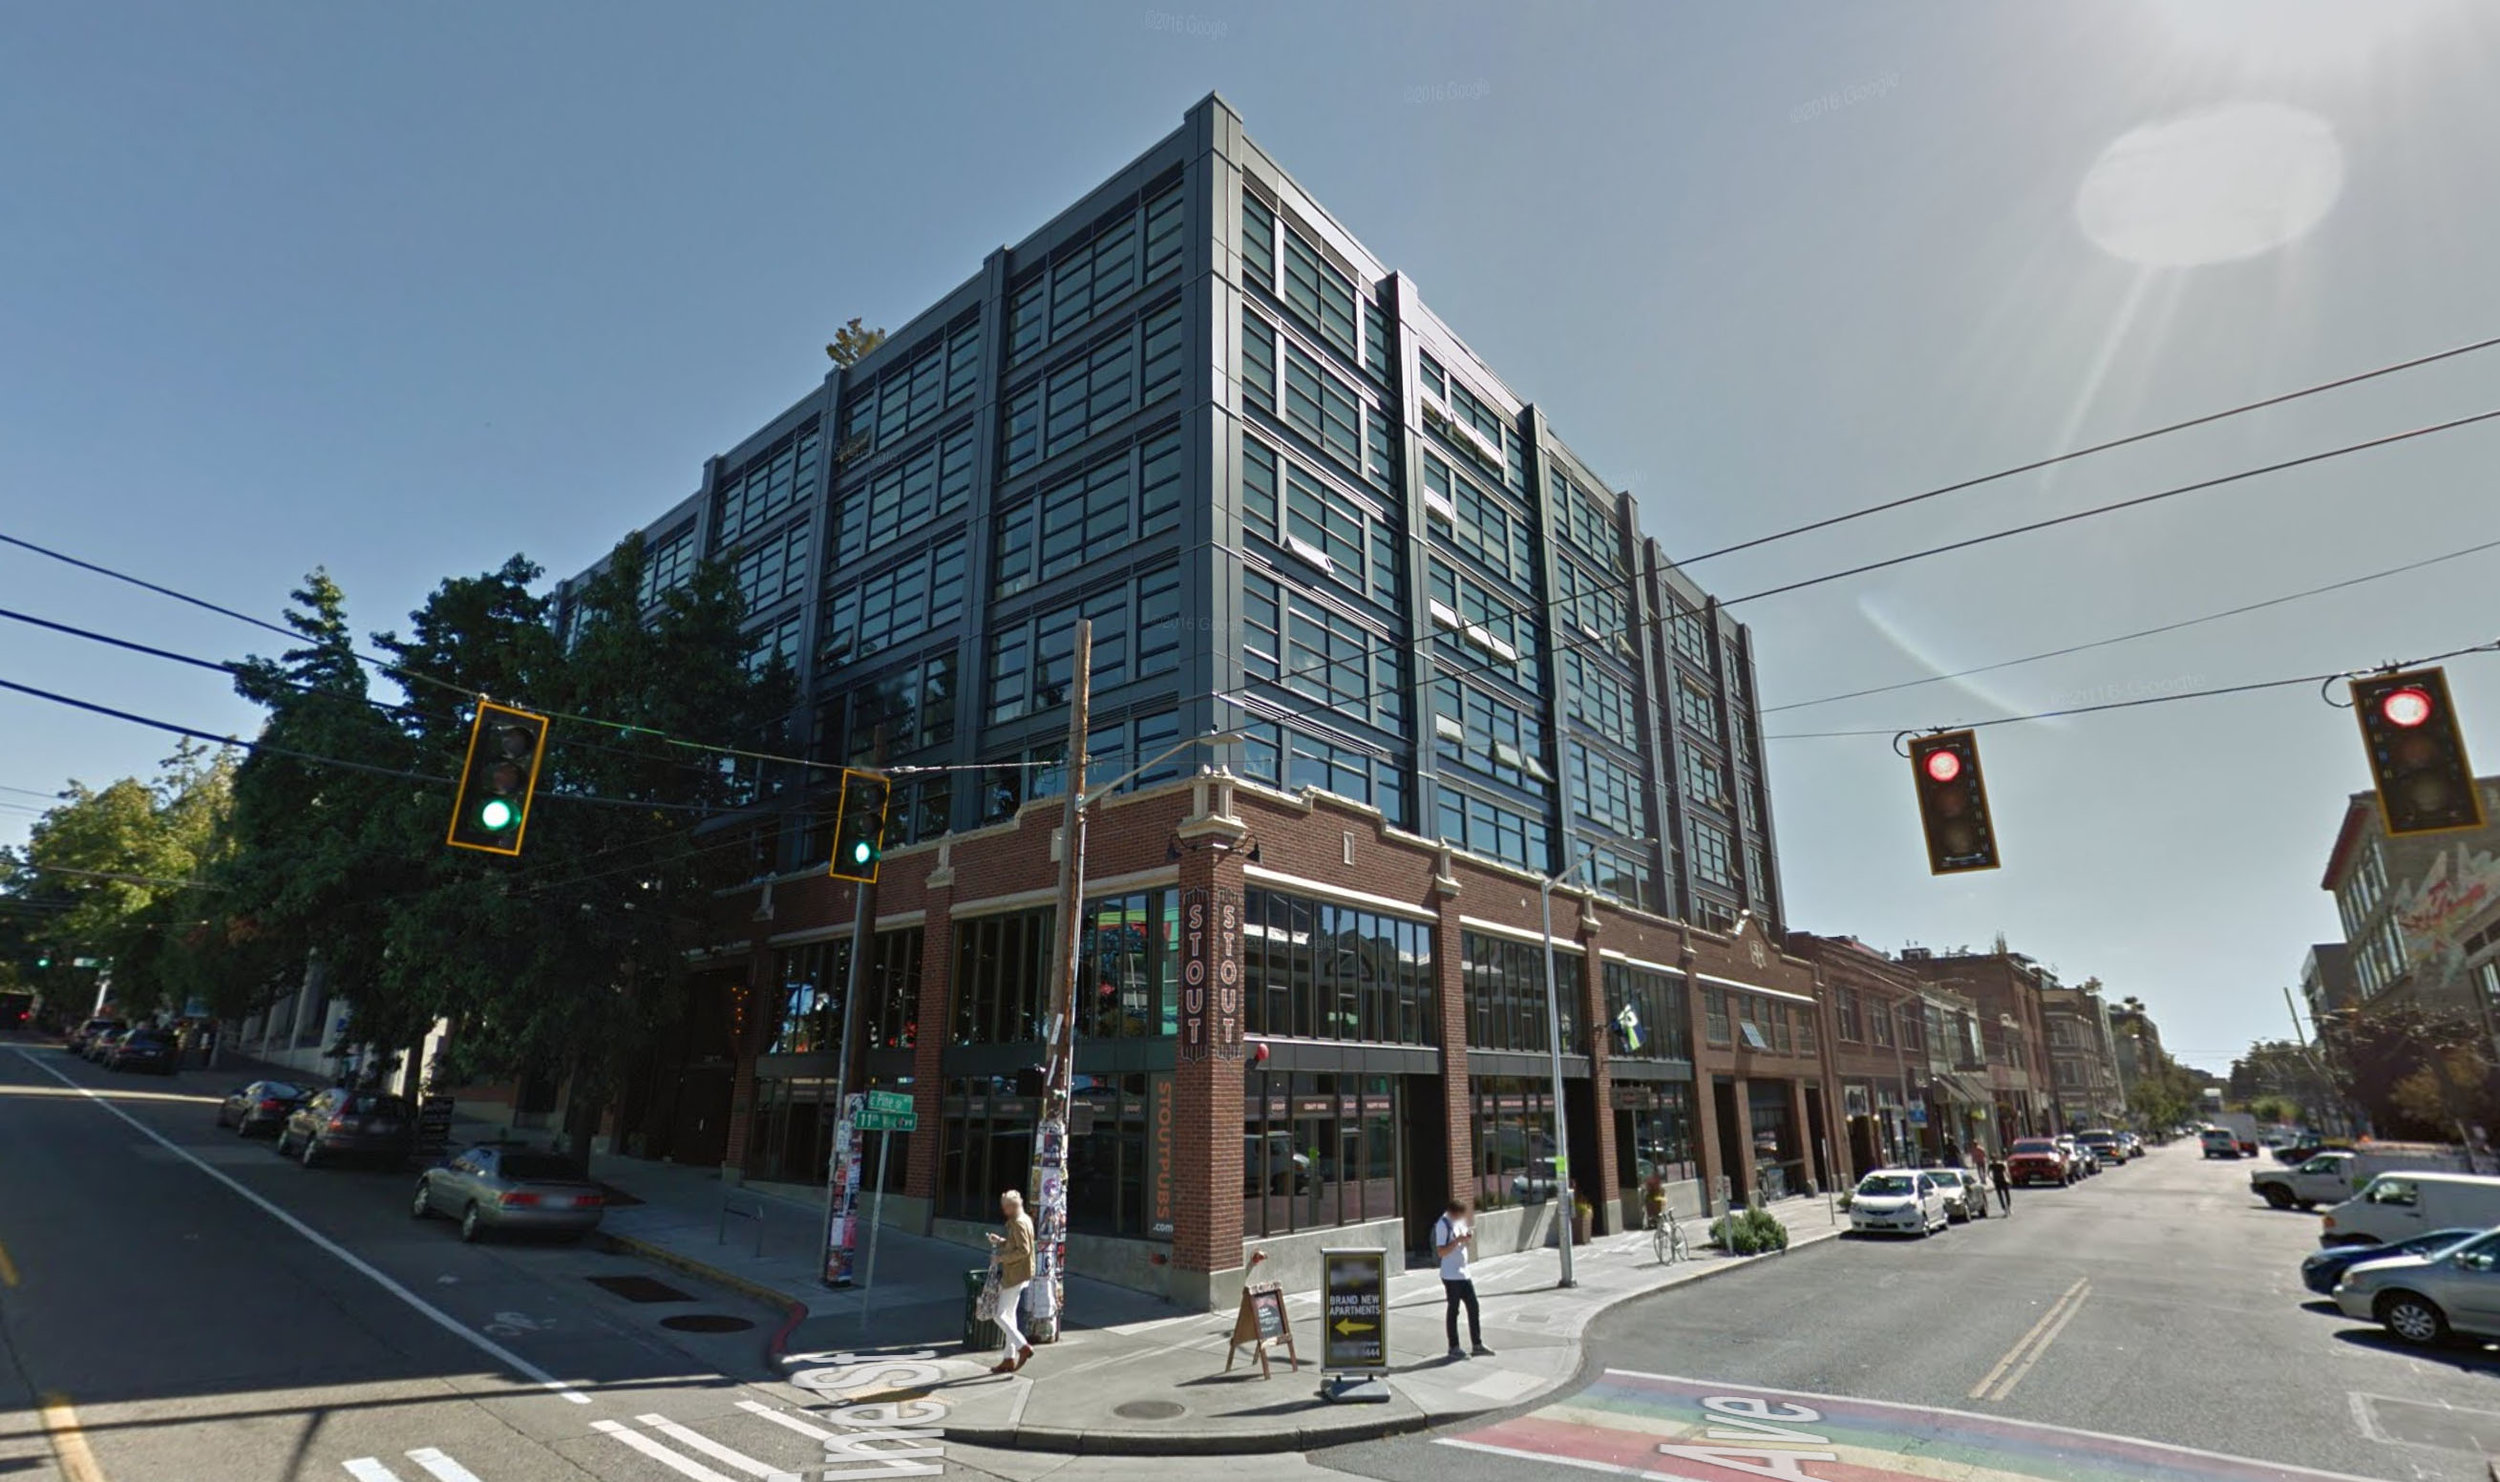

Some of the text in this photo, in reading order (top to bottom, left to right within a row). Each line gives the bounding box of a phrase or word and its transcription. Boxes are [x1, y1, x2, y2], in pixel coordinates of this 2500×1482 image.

[1186, 904, 1204, 1044] STOUT
[1220, 904, 1237, 1044] STOUT
[877, 1093, 894, 1109] Pine
[1156, 1081, 1172, 1219] STOUTPUBS
[1153, 1223, 1174, 1233] .com
[1330, 1294, 1380, 1305] BRAND NEW
[1330, 1304, 1380, 1316] APARTMENTS
